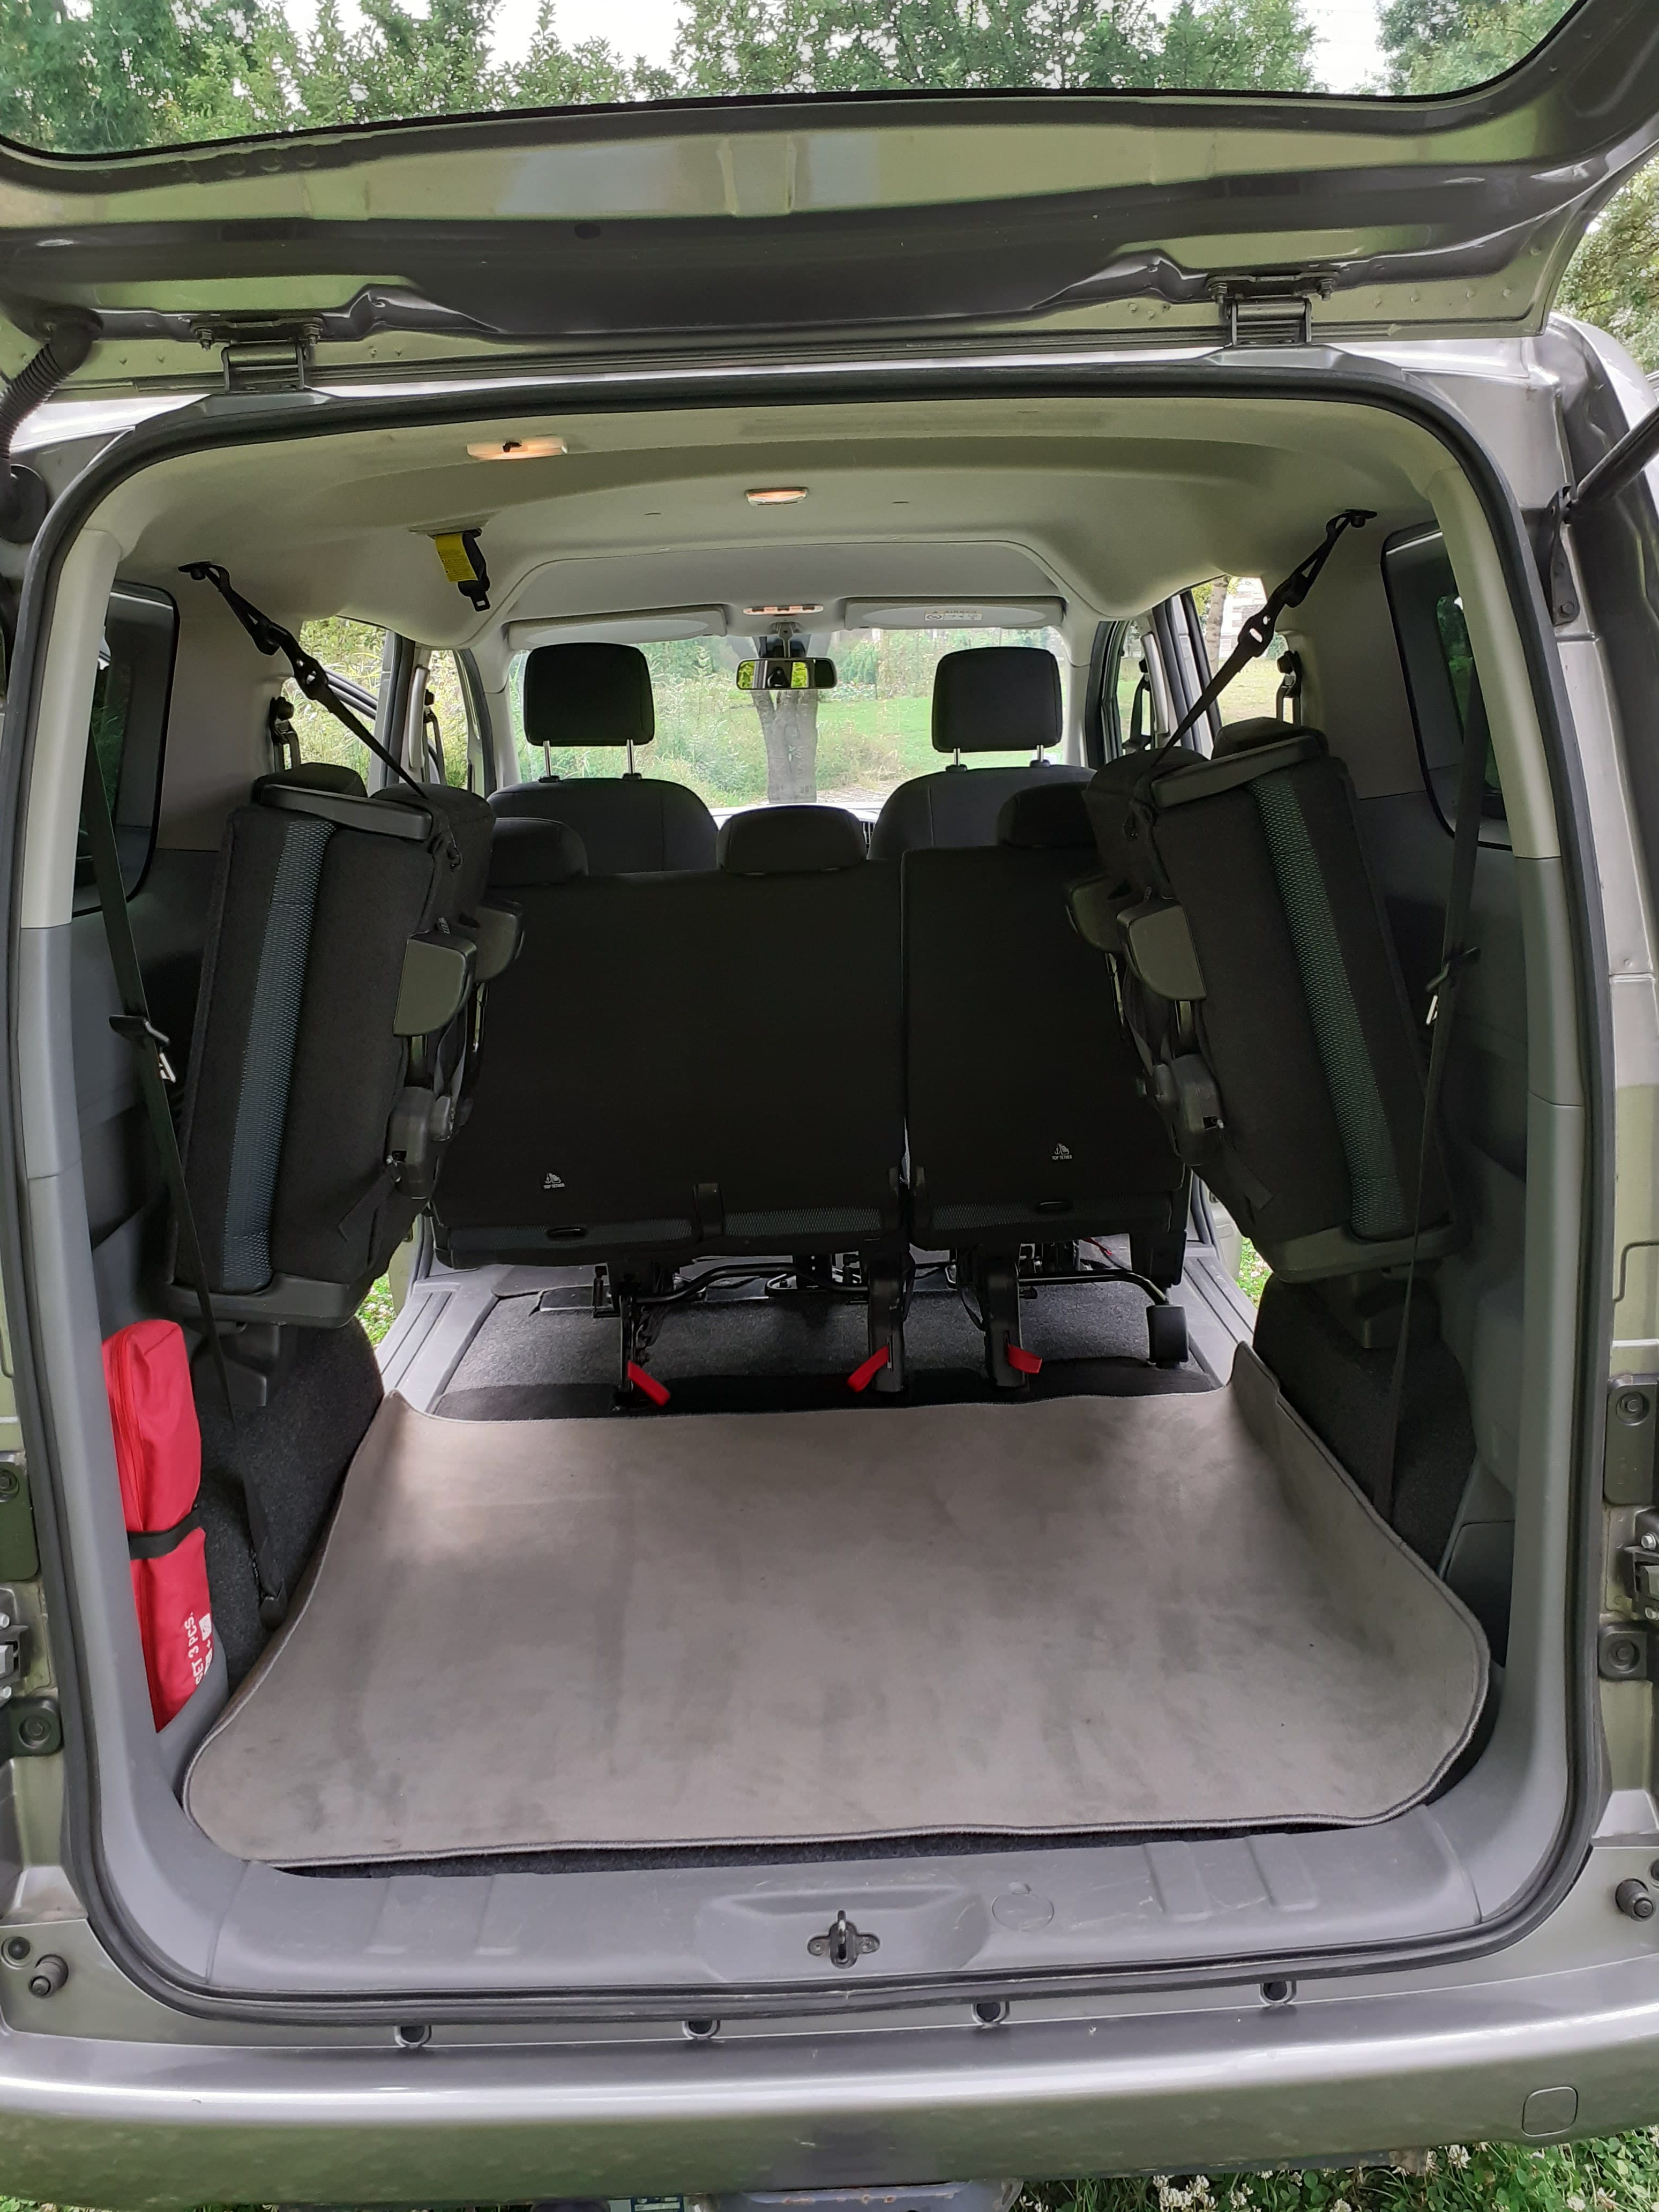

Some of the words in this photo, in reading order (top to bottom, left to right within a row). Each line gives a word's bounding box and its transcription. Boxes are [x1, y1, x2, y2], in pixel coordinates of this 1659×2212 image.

[184, 1612, 198, 1647] PCS.
[188, 1646, 199, 1658] 3
[191, 1657, 204, 1685] SET
